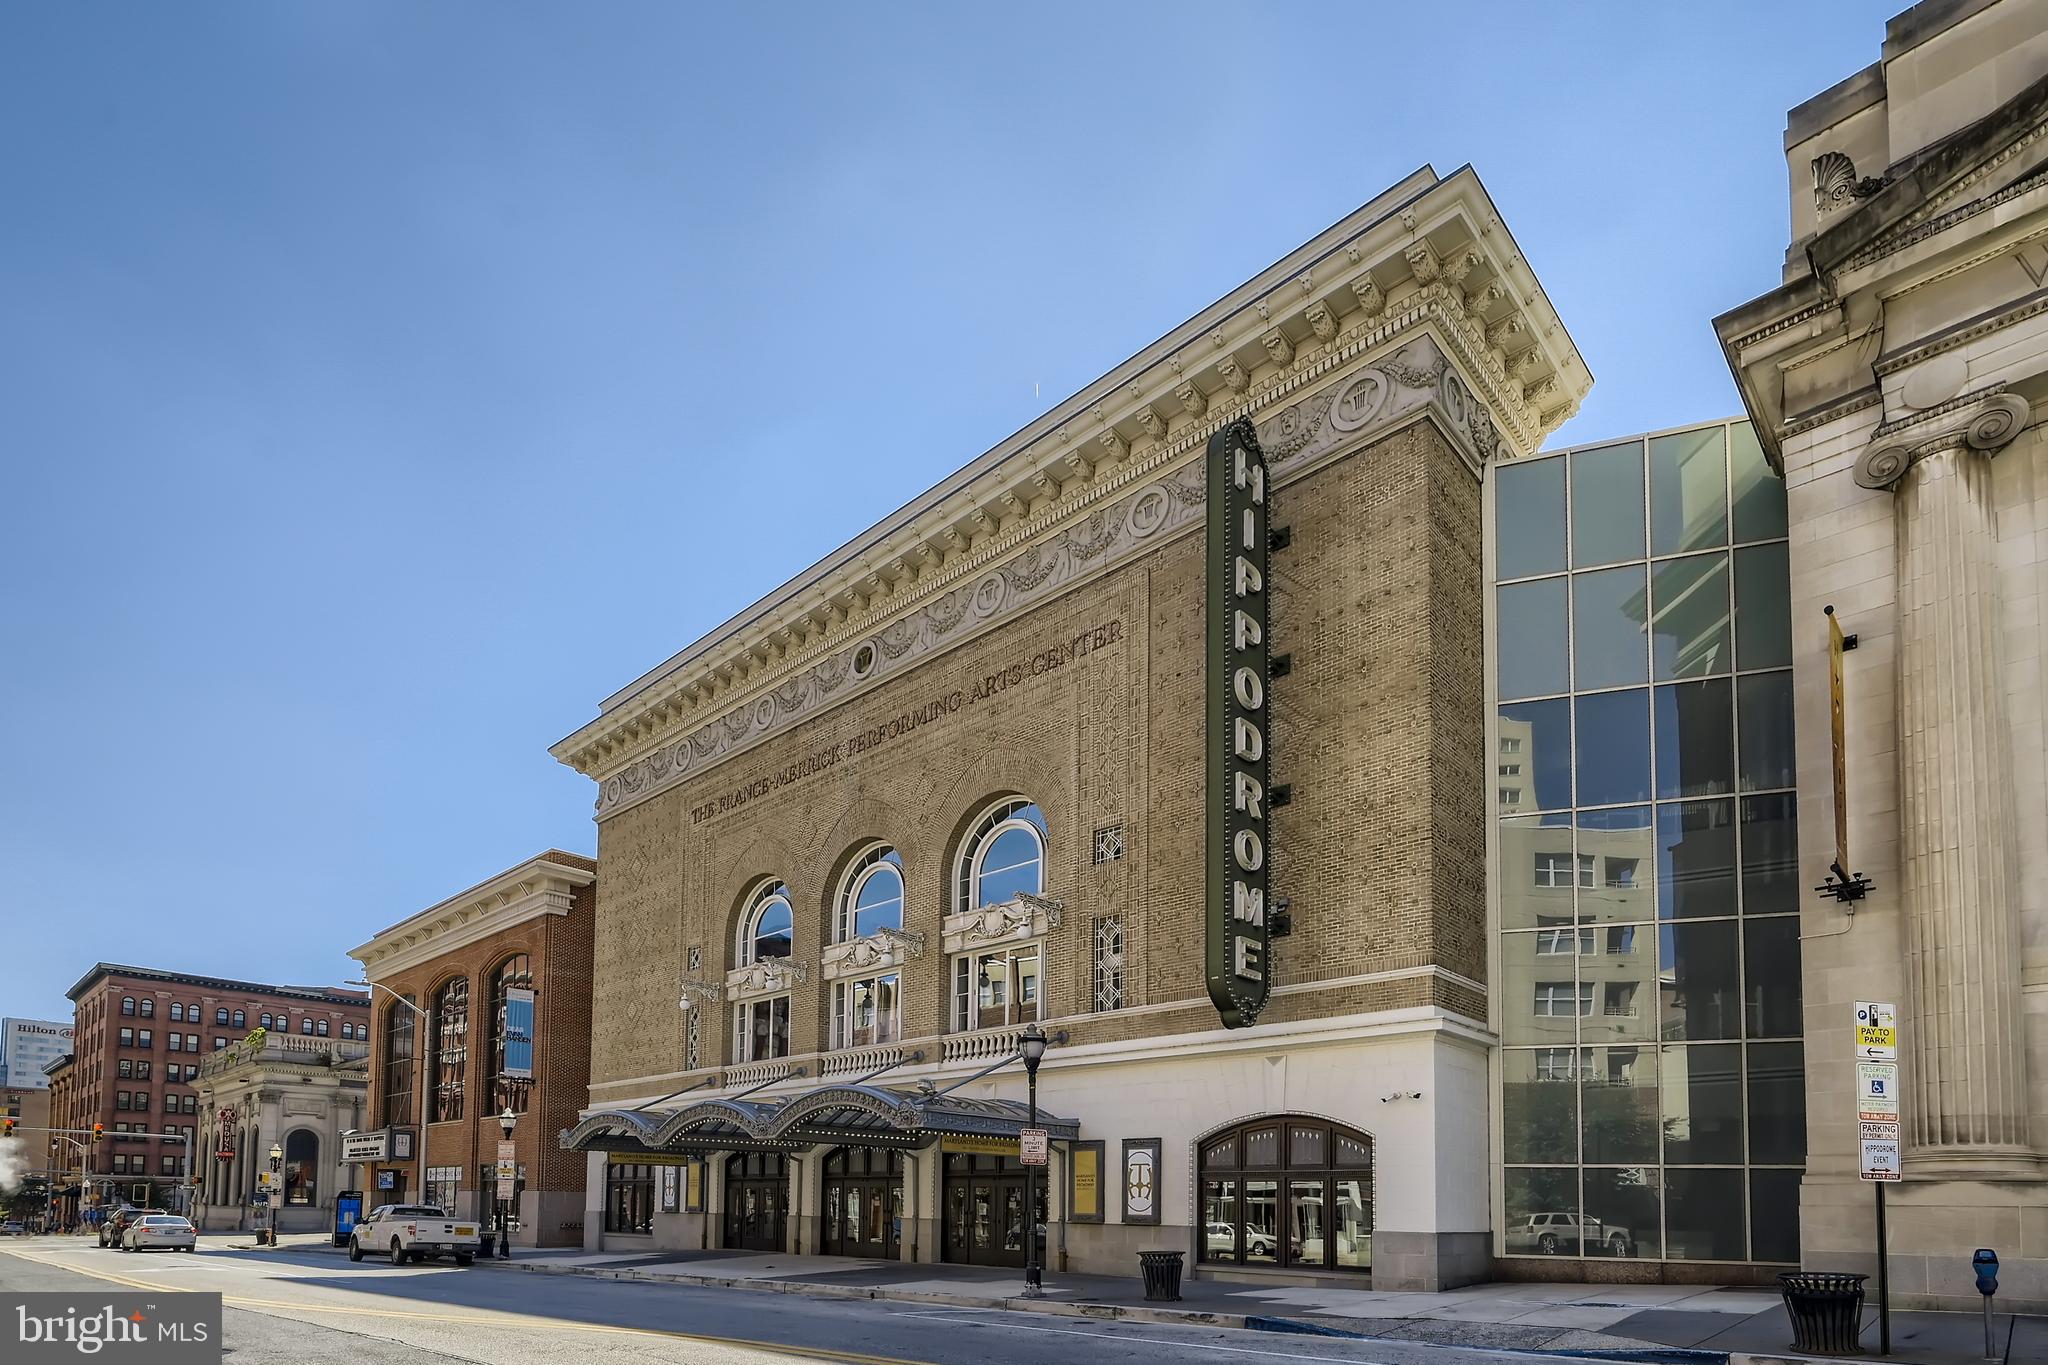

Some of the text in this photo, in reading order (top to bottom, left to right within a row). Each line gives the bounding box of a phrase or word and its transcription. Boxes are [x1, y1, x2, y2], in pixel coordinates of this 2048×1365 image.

[1234, 447, 1264, 982] HIPPODROME
[691, 618, 1124, 825] THE FRANCE-MERRICK PERFORMING ARTS CENTER
[17, 1024, 57, 1035] Hilton
[1864, 1036, 1887, 1044] PARK
[1864, 1072, 1891, 1080] PARKING
[1862, 1124, 1896, 1133] PARKING
[1865, 1145, 1896, 1153] HIPPODROME
